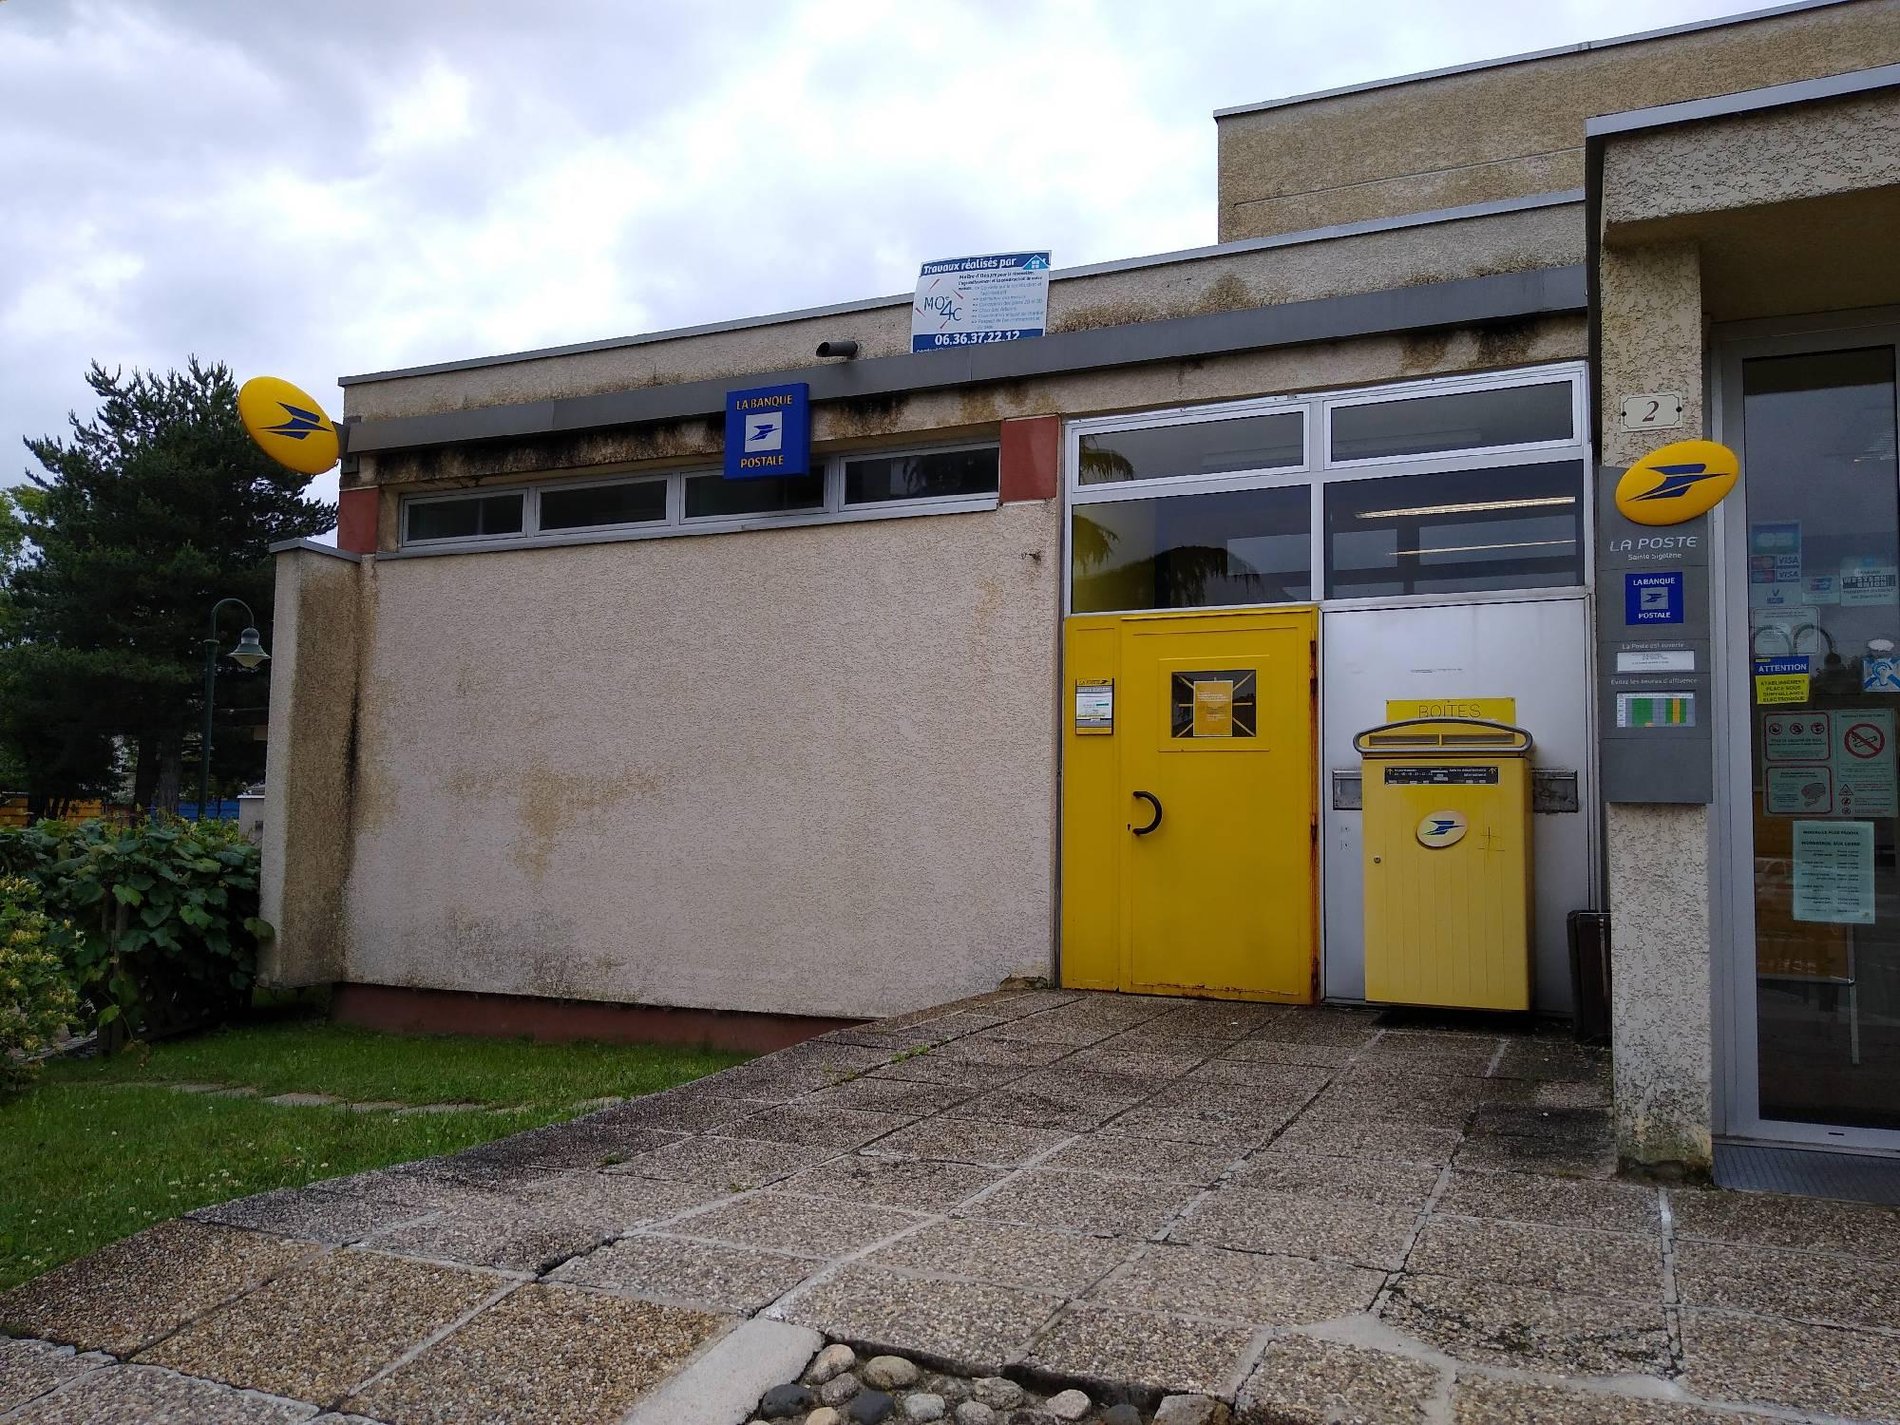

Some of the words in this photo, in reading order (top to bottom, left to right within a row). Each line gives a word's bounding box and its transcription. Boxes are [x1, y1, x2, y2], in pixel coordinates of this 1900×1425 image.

[923, 262, 960, 275] Travaux
[961, 257, 998, 271] réalisés
[998, 256, 1017, 268] par
[935, 330, 1021, 346] 06.36.37.22.12
[736, 399, 749, 411] LA
[750, 394, 793, 408] BANQUE
[1641, 399, 1660, 422] 2
[740, 455, 785, 469] POSTALE
[1609, 539, 1632, 552] LA
[1637, 536, 1699, 550] POSTE
[1643, 577, 1676, 585] BANQUE
[1638, 611, 1672, 619] POSTALE
[1758, 663, 1807, 673] ATTENTION
[1418, 703, 1482, 719] BOITES
